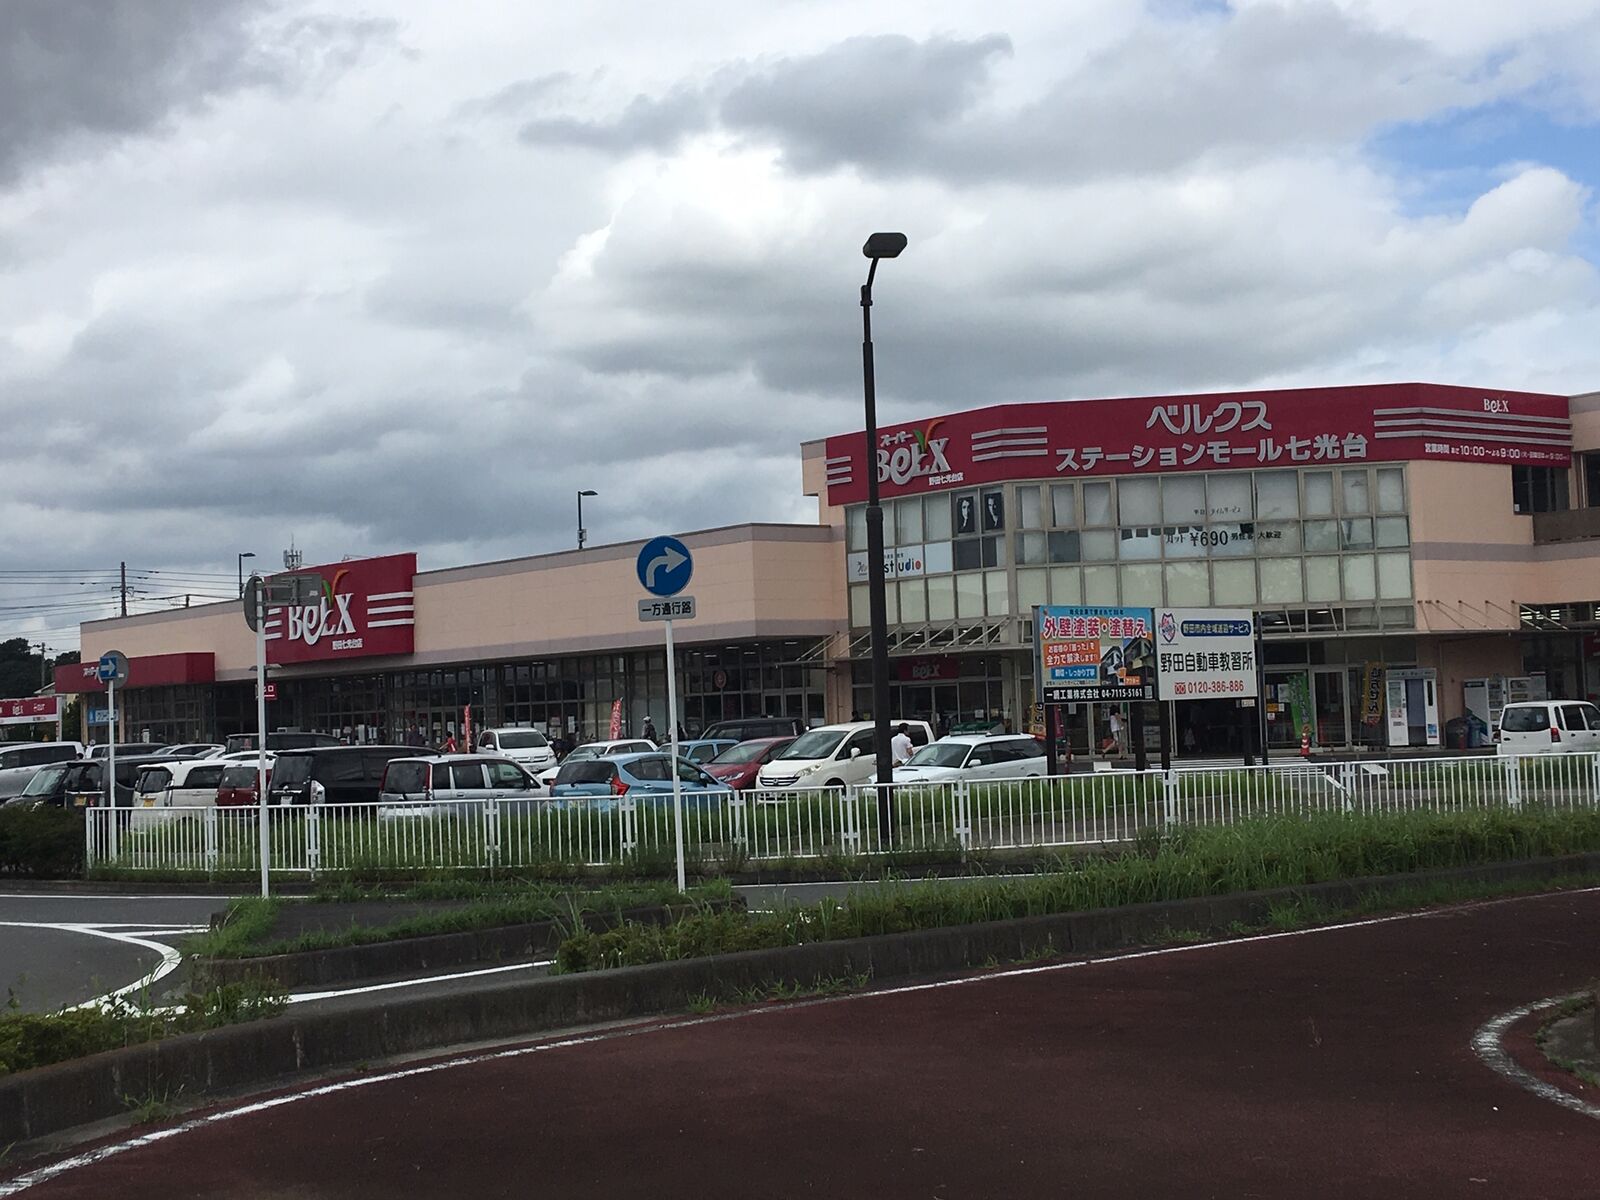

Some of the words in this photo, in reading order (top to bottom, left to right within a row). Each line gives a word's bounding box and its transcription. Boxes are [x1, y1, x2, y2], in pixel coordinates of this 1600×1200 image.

[1146, 401, 1272, 434] ベルクス
[1056, 433, 1367, 471] ステーションモール七光台
[1190, 530, 1228, 546] ¥690
[641, 601, 692, 616] 一方通行路
[1043, 616, 1147, 639] 外壁塗装・塗替え
[1160, 651, 1253, 673] 野田自動車教習所
[1101, 688, 1142, 698] 04-7115-5161
[1188, 680, 1244, 694] 0120-386-886
